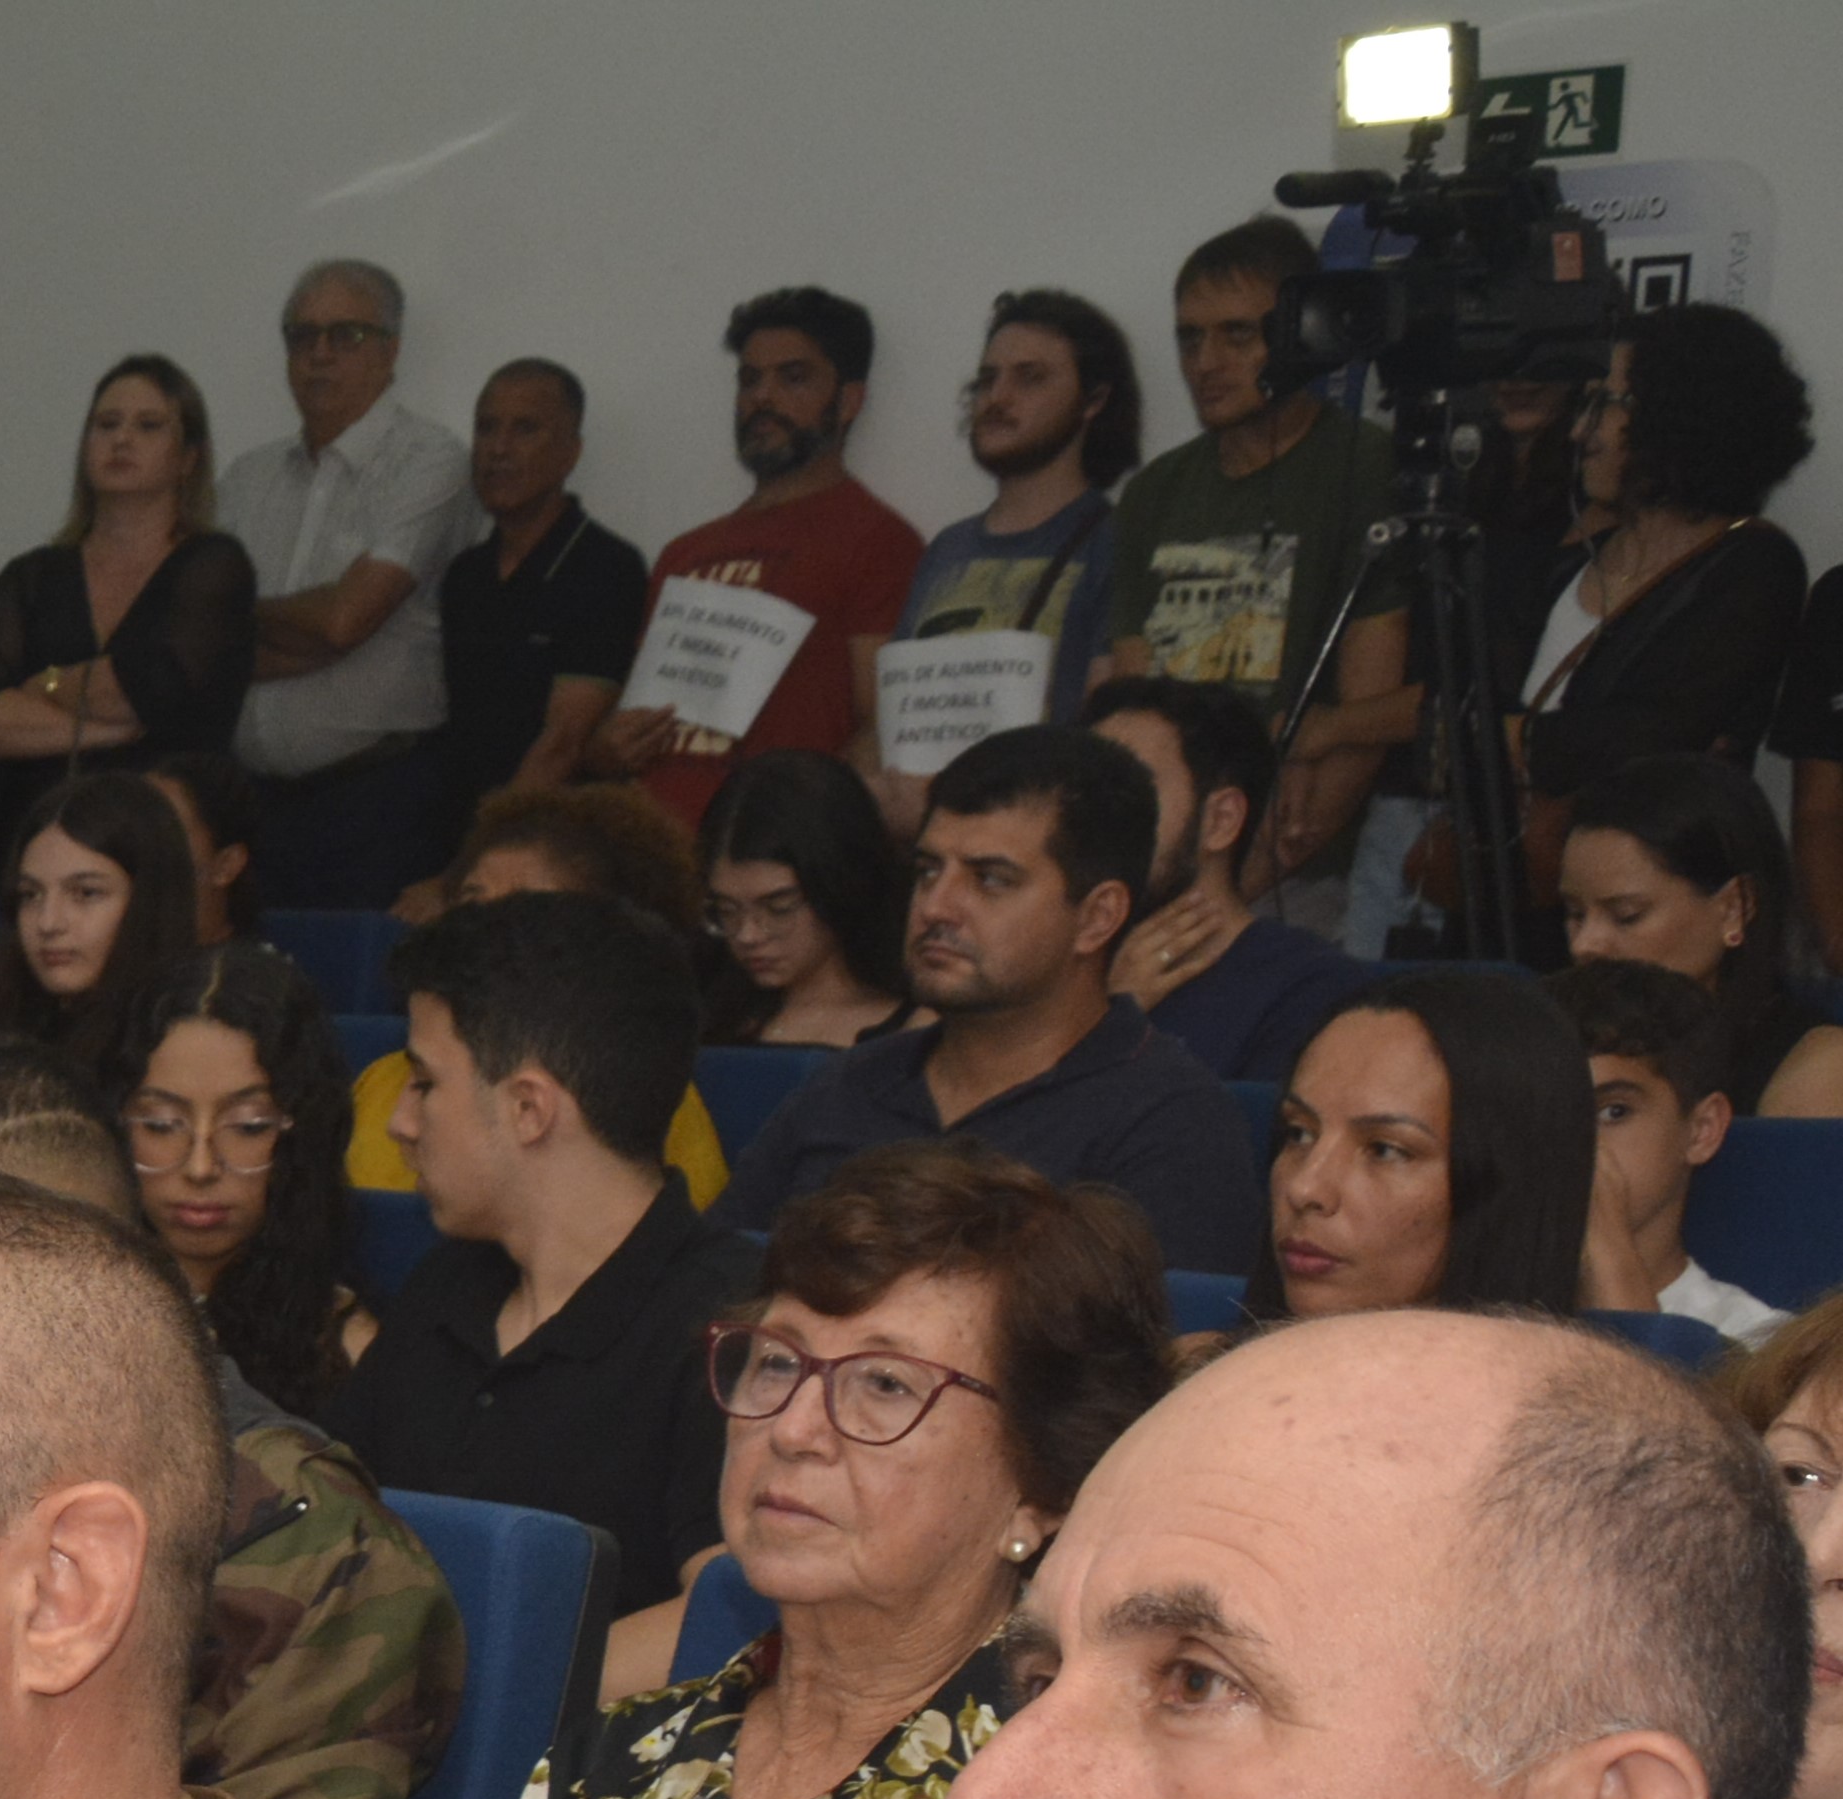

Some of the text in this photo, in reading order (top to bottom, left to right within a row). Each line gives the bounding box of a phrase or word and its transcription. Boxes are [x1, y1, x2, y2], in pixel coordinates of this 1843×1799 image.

[706, 608, 787, 646] AUMENTO
[938, 658, 1034, 679] AUMENTO
[912, 693, 978, 711] IMORAL
